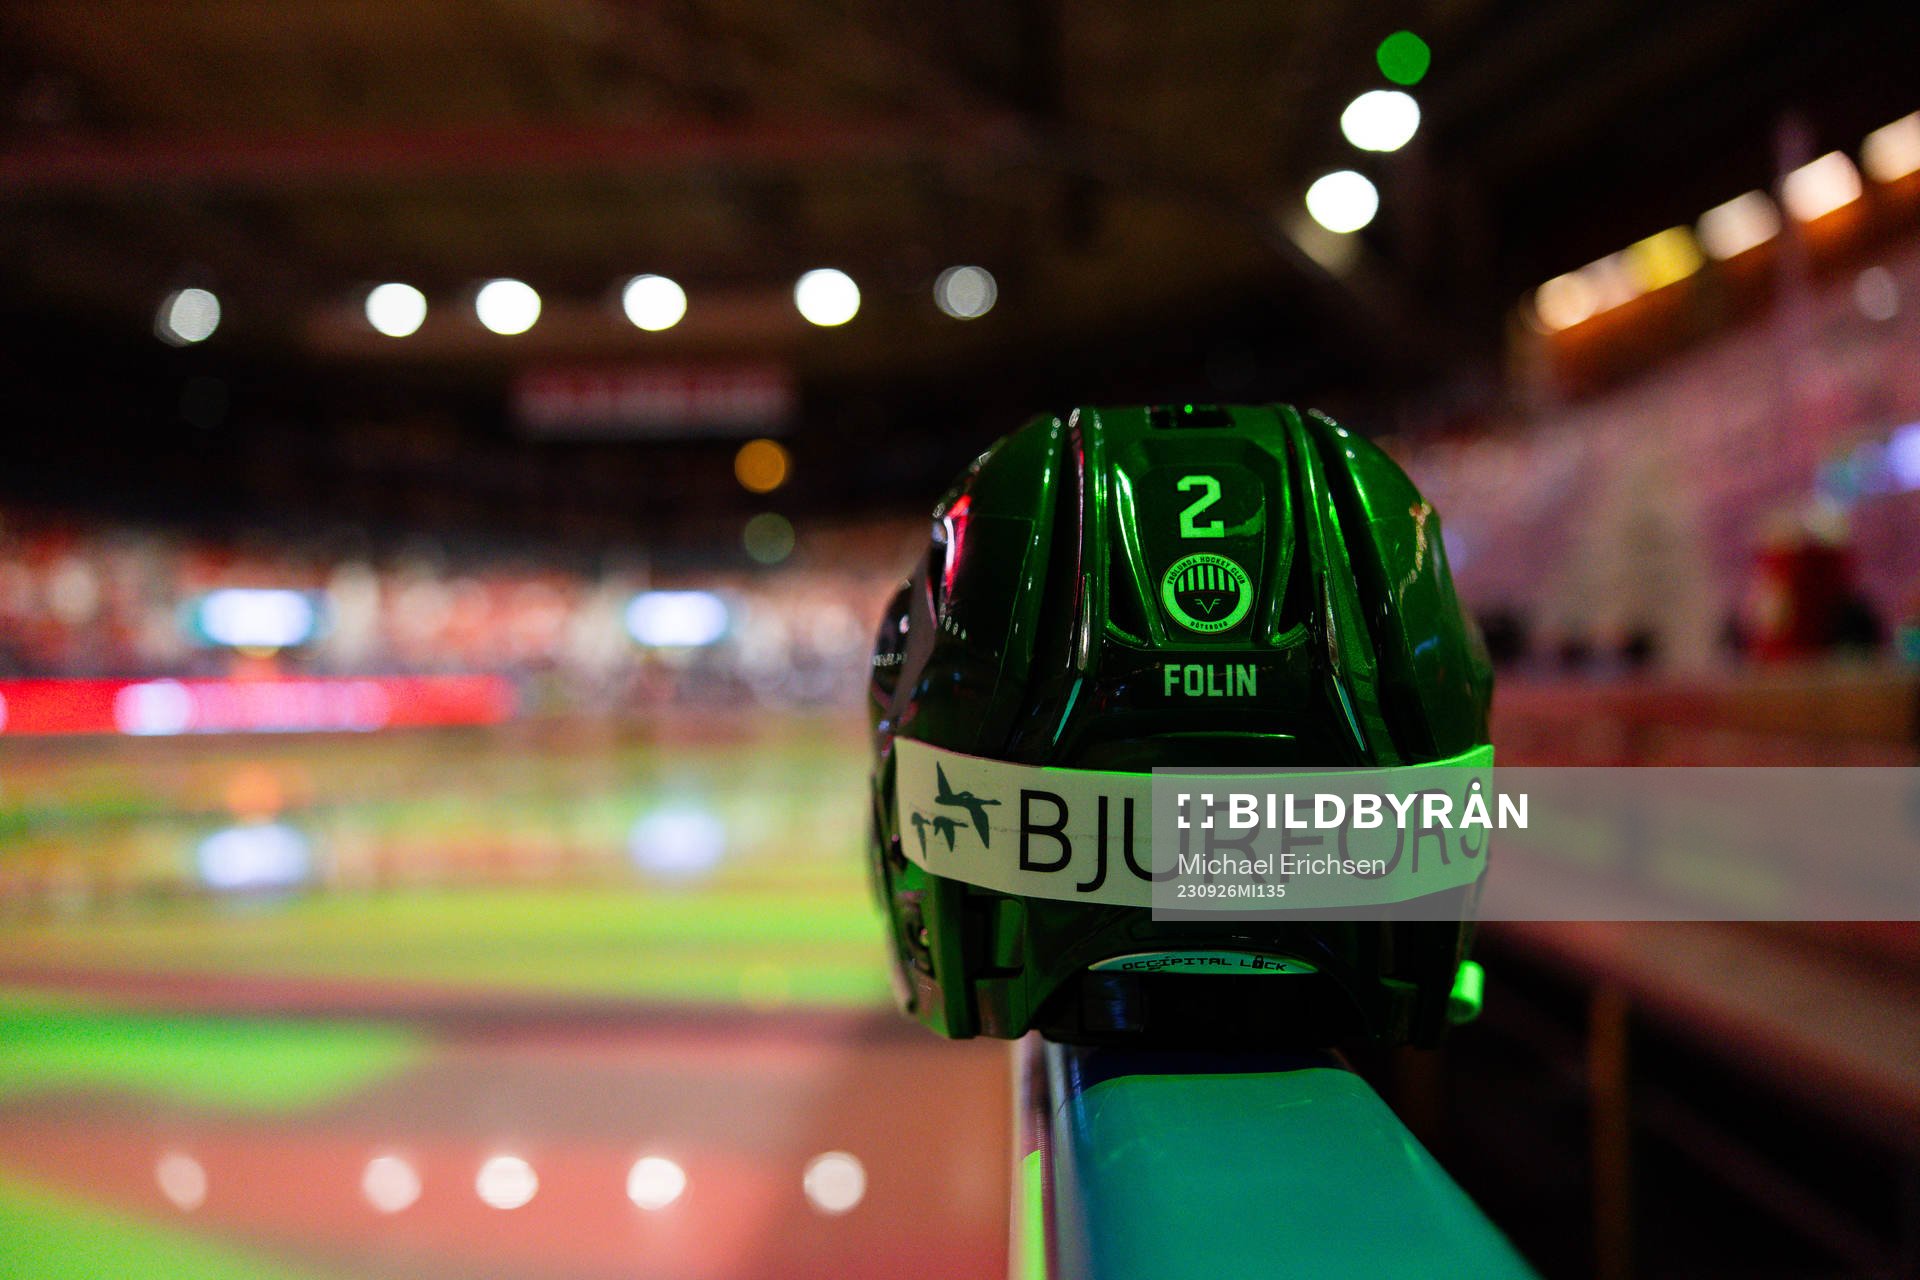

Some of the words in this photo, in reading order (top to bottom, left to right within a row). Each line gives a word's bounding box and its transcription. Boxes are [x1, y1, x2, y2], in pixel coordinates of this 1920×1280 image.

[1177, 475, 1225, 538] 2
[1200, 556, 1232, 569] HOCKEY
[1231, 567, 1246, 585] CLUB
[1164, 664, 1257, 697] FOLIN
[1019, 776, 1483, 893] BJURFORS
[1122, 957, 1232, 971] OCCIPITAL
